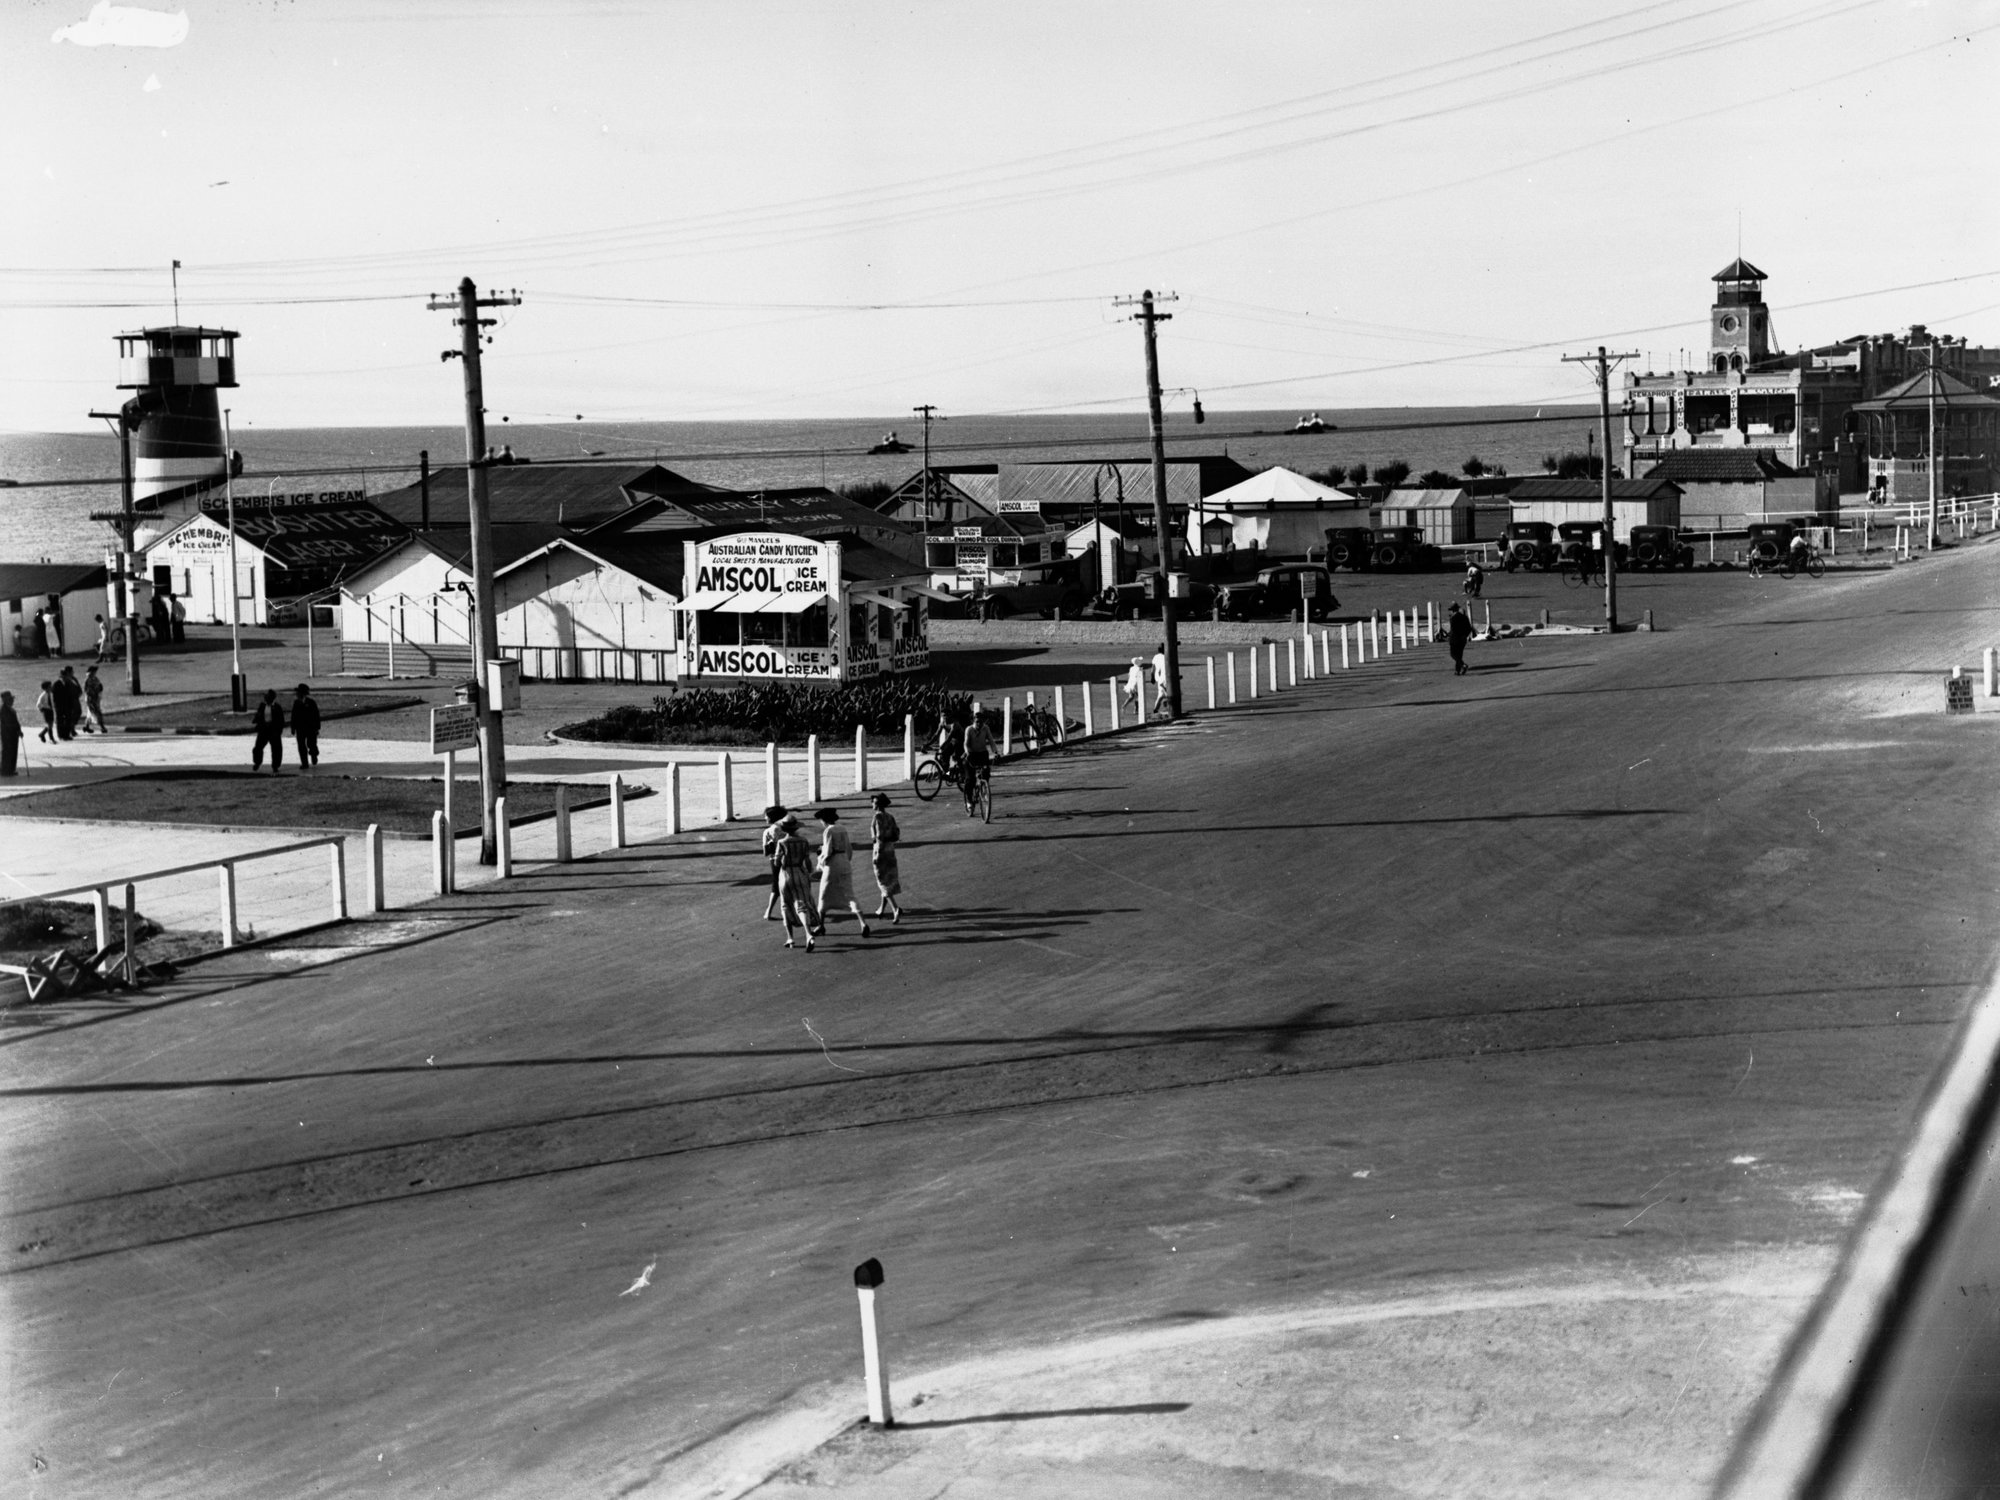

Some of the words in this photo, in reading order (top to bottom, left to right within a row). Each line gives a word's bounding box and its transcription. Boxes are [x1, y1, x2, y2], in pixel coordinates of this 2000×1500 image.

[290, 492, 314, 505] ICE
[318, 490, 364, 503] CREAM
[1001, 502, 1022, 512] AMSCOL
[228, 509, 394, 536] BOSHTER
[708, 543, 756, 556] AUSTRALIAN
[759, 544, 783, 556] CANDY
[785, 545, 818, 556] KITCHEN
[959, 545, 986, 553] AMSCOL
[797, 567, 818, 578] ICE
[696, 566, 782, 593] AMSCOL
[786, 581, 827, 593] CREAM
[895, 635, 929, 656] AMSCOL
[699, 651, 783, 673] AMSCOL
[906, 654, 929, 668] CREAM
[785, 665, 829, 675] CREAM
[858, 662, 880, 675] CREAM
